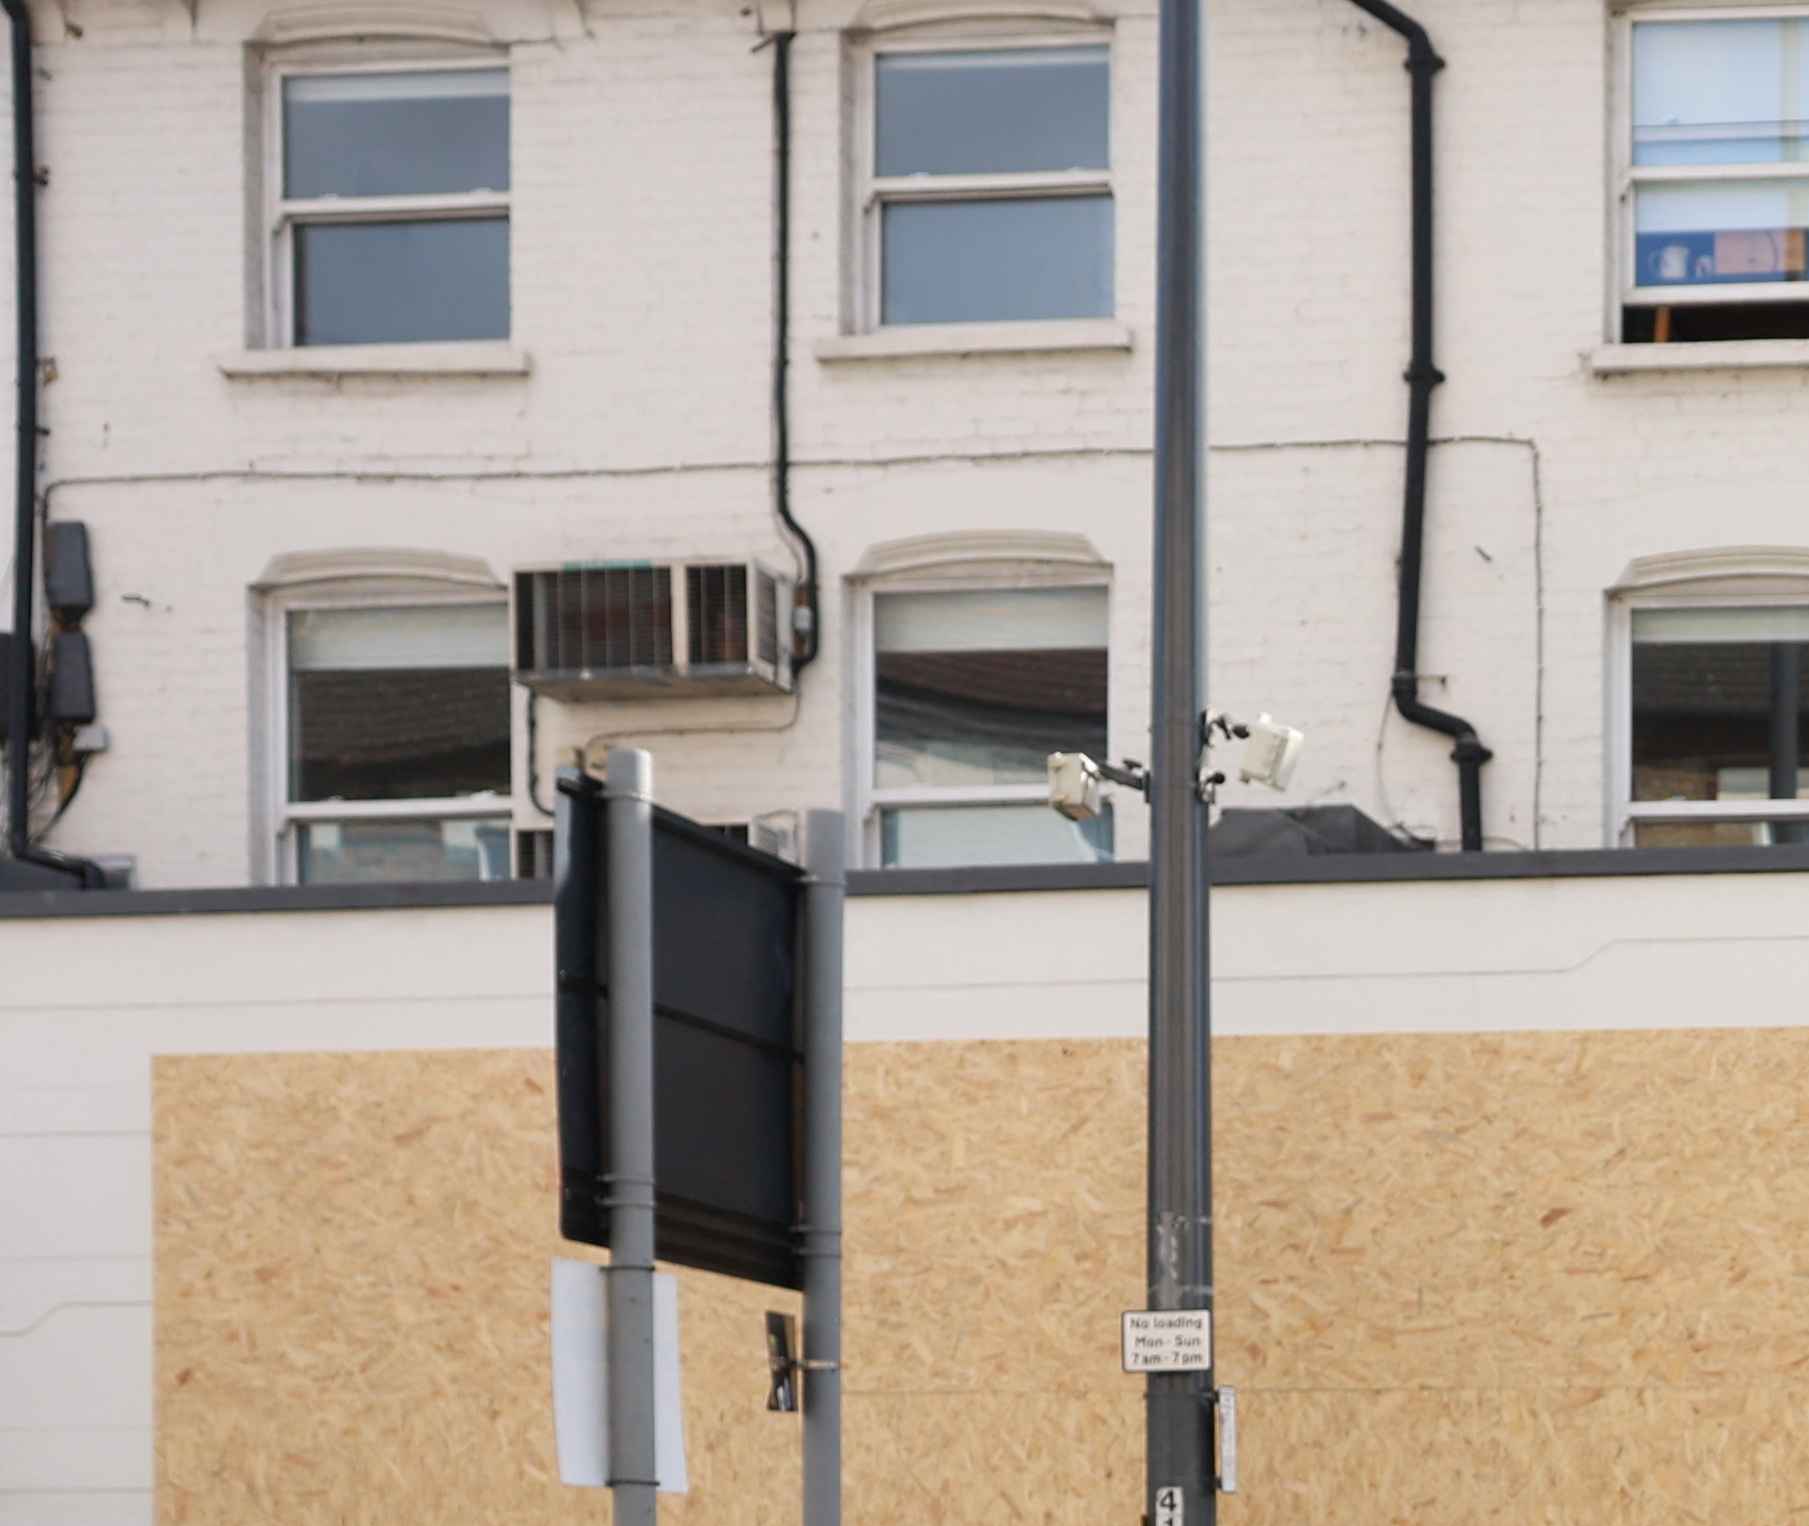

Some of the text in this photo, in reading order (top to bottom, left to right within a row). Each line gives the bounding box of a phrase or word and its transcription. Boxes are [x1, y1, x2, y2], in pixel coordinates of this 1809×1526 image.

[1130, 1315, 1203, 1330] No loading
[1134, 1336, 1163, 1347] Mon
[1175, 1334, 1201, 1347] Sun
